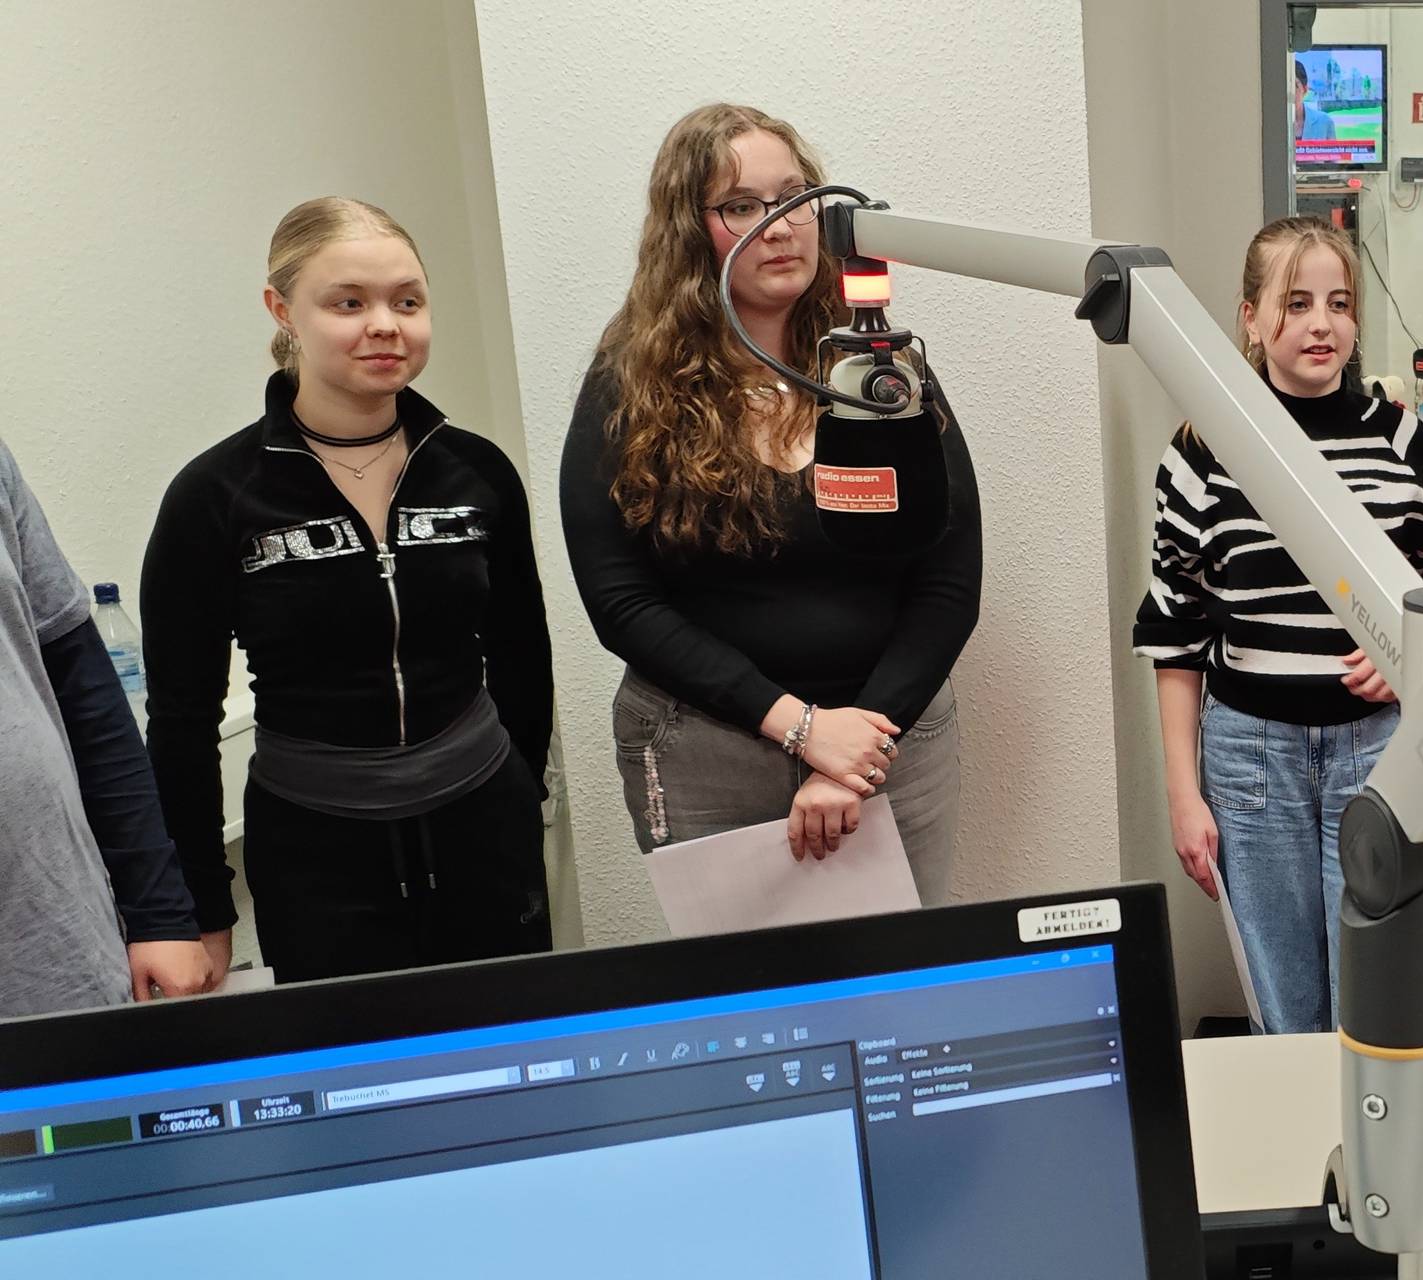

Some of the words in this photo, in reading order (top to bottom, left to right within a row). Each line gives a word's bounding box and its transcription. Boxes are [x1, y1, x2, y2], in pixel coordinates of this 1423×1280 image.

[817, 471, 840, 482] radio
[840, 474, 880, 483] essen
[253, 1103, 303, 1121] 13:33:20
